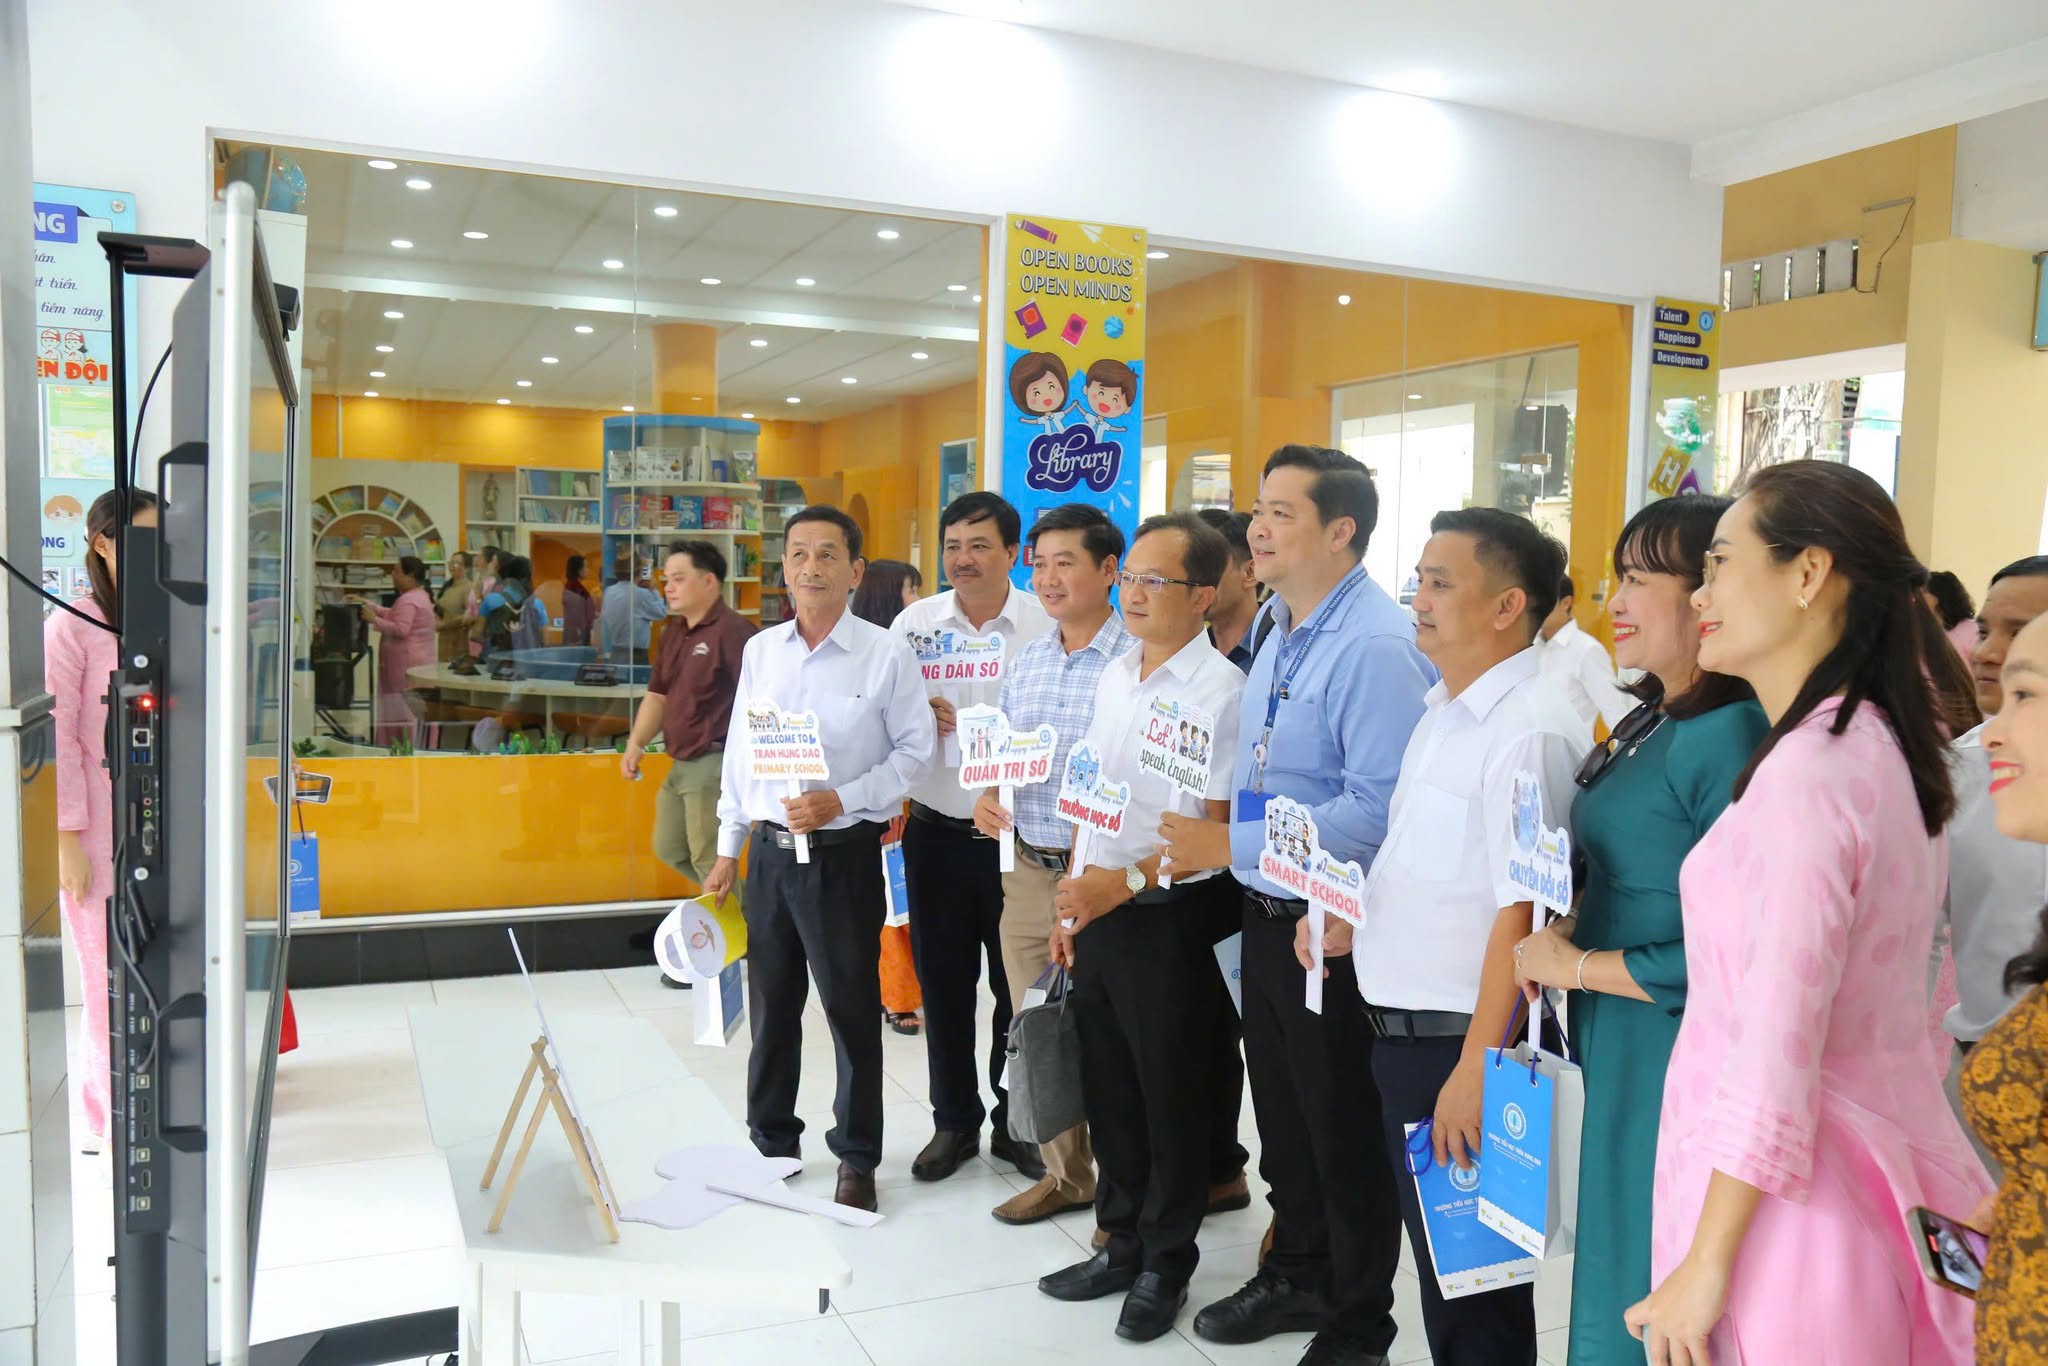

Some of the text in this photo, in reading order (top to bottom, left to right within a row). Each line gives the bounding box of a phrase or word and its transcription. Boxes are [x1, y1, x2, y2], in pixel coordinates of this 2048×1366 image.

[1021, 247, 1133, 277] OPEN BOOKS
[1021, 274, 1132, 303] OPEN MINDS
[1660, 310, 1683, 323] Talent
[1658, 330, 1696, 345] Happiness
[65, 358, 108, 385] ĐỘI
[1657, 351, 1704, 367] Development
[1035, 433, 1113, 484] Library
[945, 659, 974, 679] DÂN
[979, 656, 1001, 677] SỐ
[758, 733, 808, 744] WELCOME TO
[1147, 718, 1176, 753] Let's
[753, 763, 825, 774] PRIMARY SCHOOL
[963, 753, 1050, 784] QUẢN TRỊ SỐ
[1140, 748, 1208, 794] speak English!
[1058, 798, 1091, 822] TRƯỜNG
[1089, 809, 1108, 829] HỌC
[1263, 857, 1361, 919] SMART SCHOOL
